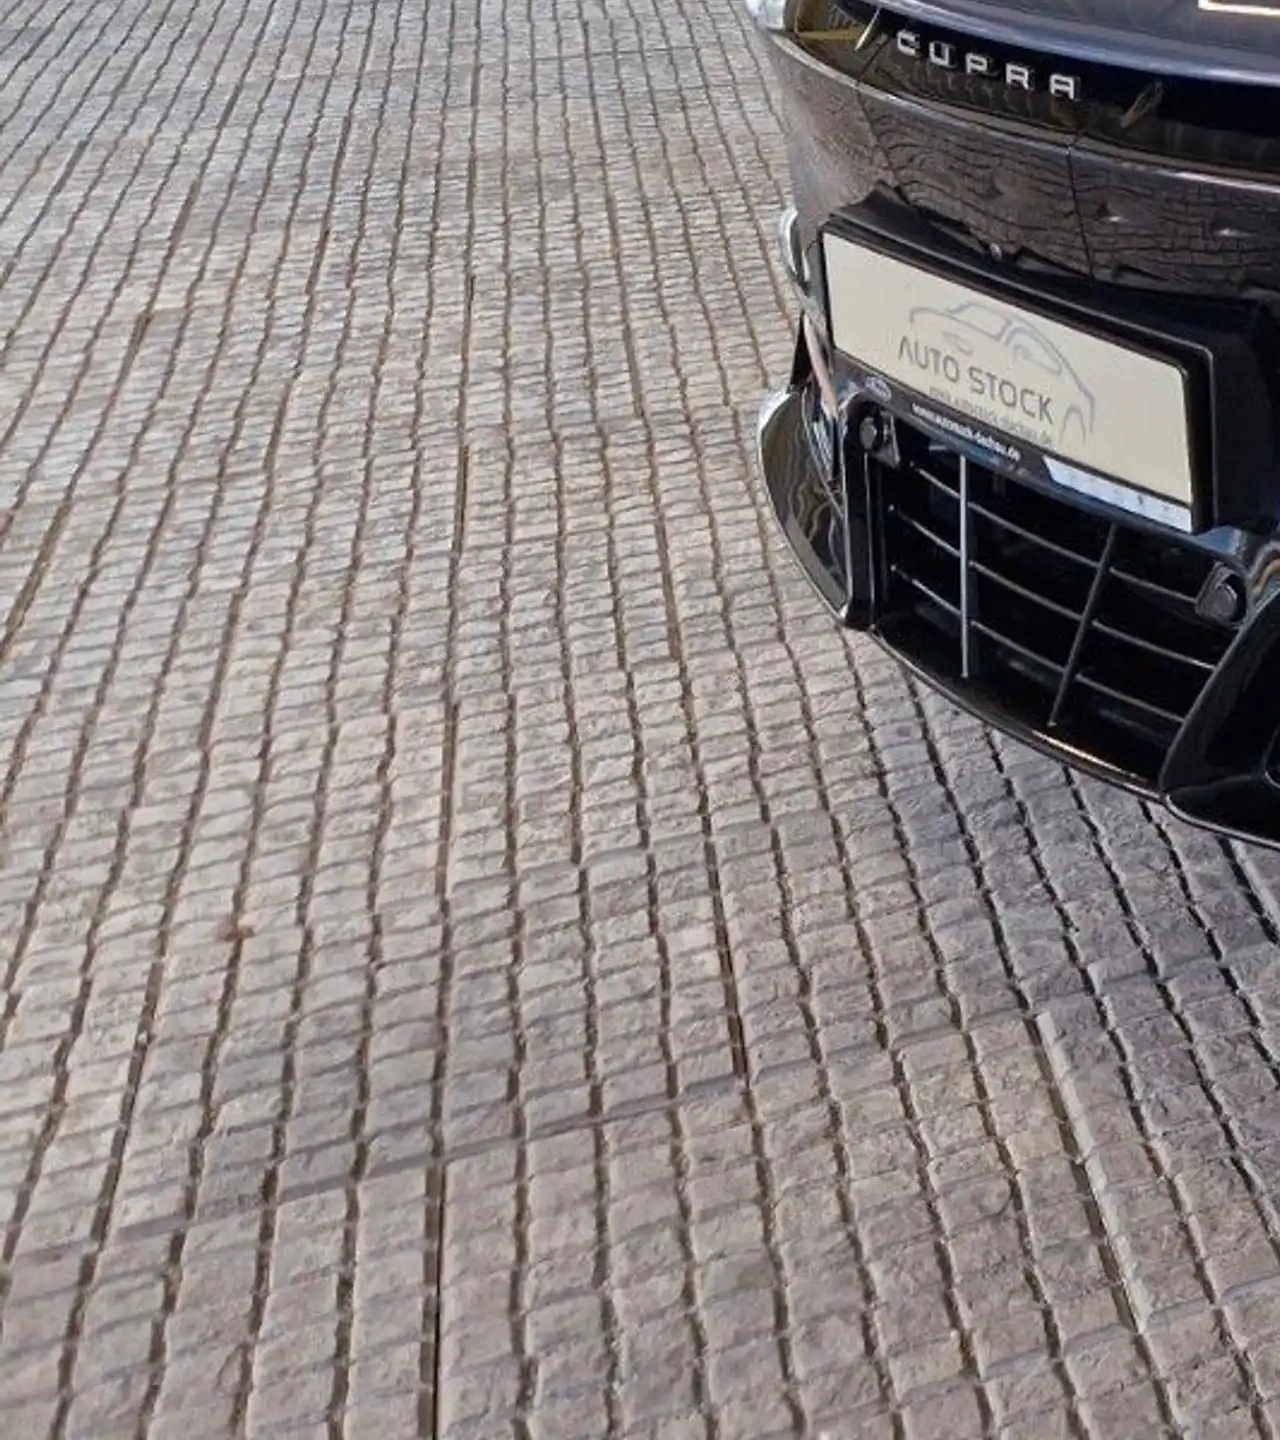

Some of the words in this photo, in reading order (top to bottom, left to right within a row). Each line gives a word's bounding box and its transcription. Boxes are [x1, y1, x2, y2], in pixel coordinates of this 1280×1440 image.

[896, 28, 1077, 101] CUPRA
[898, 335, 961, 384] AUTO
[968, 366, 1055, 426] STOCK
